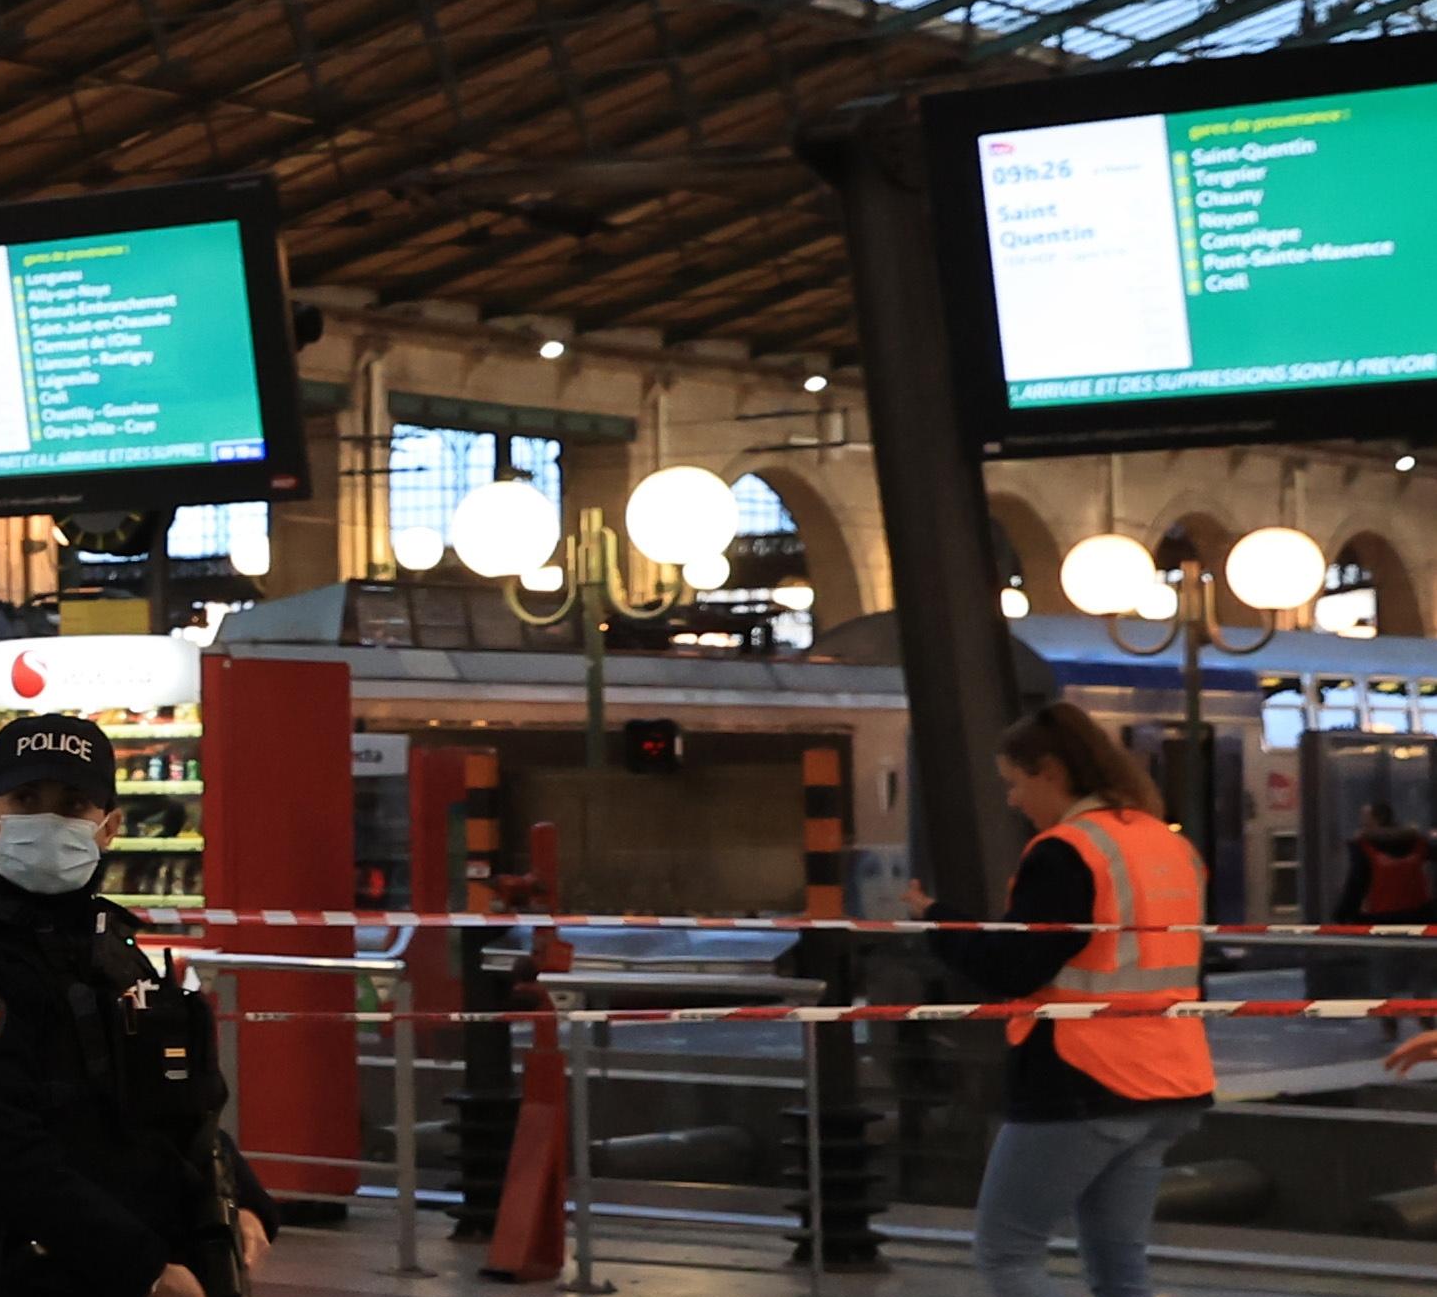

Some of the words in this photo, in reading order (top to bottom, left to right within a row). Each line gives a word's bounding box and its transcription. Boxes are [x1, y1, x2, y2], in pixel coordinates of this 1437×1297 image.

[1192, 137, 1317, 166] Saint-Quentin
[992, 160, 1073, 186] 09h26
[1192, 166, 1267, 188] Tergnier
[1195, 188, 1264, 208] Chauny
[998, 203, 1057, 223] Saint
[1198, 211, 1259, 230] Noyon
[1000, 225, 1095, 250] Quentin
[1200, 228, 1302, 251] Compiègne
[1202, 241, 1395, 272] Pont-Sainte-Maxence
[1204, 273, 1249, 292] Creil
[34, 338, 88, 353] Clermont
[90, 336, 106, 348] de
[38, 372, 100, 389] Laigneville
[1023, 379, 1090, 400] ARRIVEE
[1119, 375, 1152, 395] DES
[1156, 365, 1287, 392] SUPPRESSIONS
[1289, 360, 1337, 383] SONT
[1339, 358, 1354, 379] A
[40, 391, 69, 405] Creil
[42, 407, 94, 422] Chantilly
[103, 403, 159, 418] Gouvieux
[124, 420, 157, 433] Coye
[17, 732, 93, 762] POLICE
